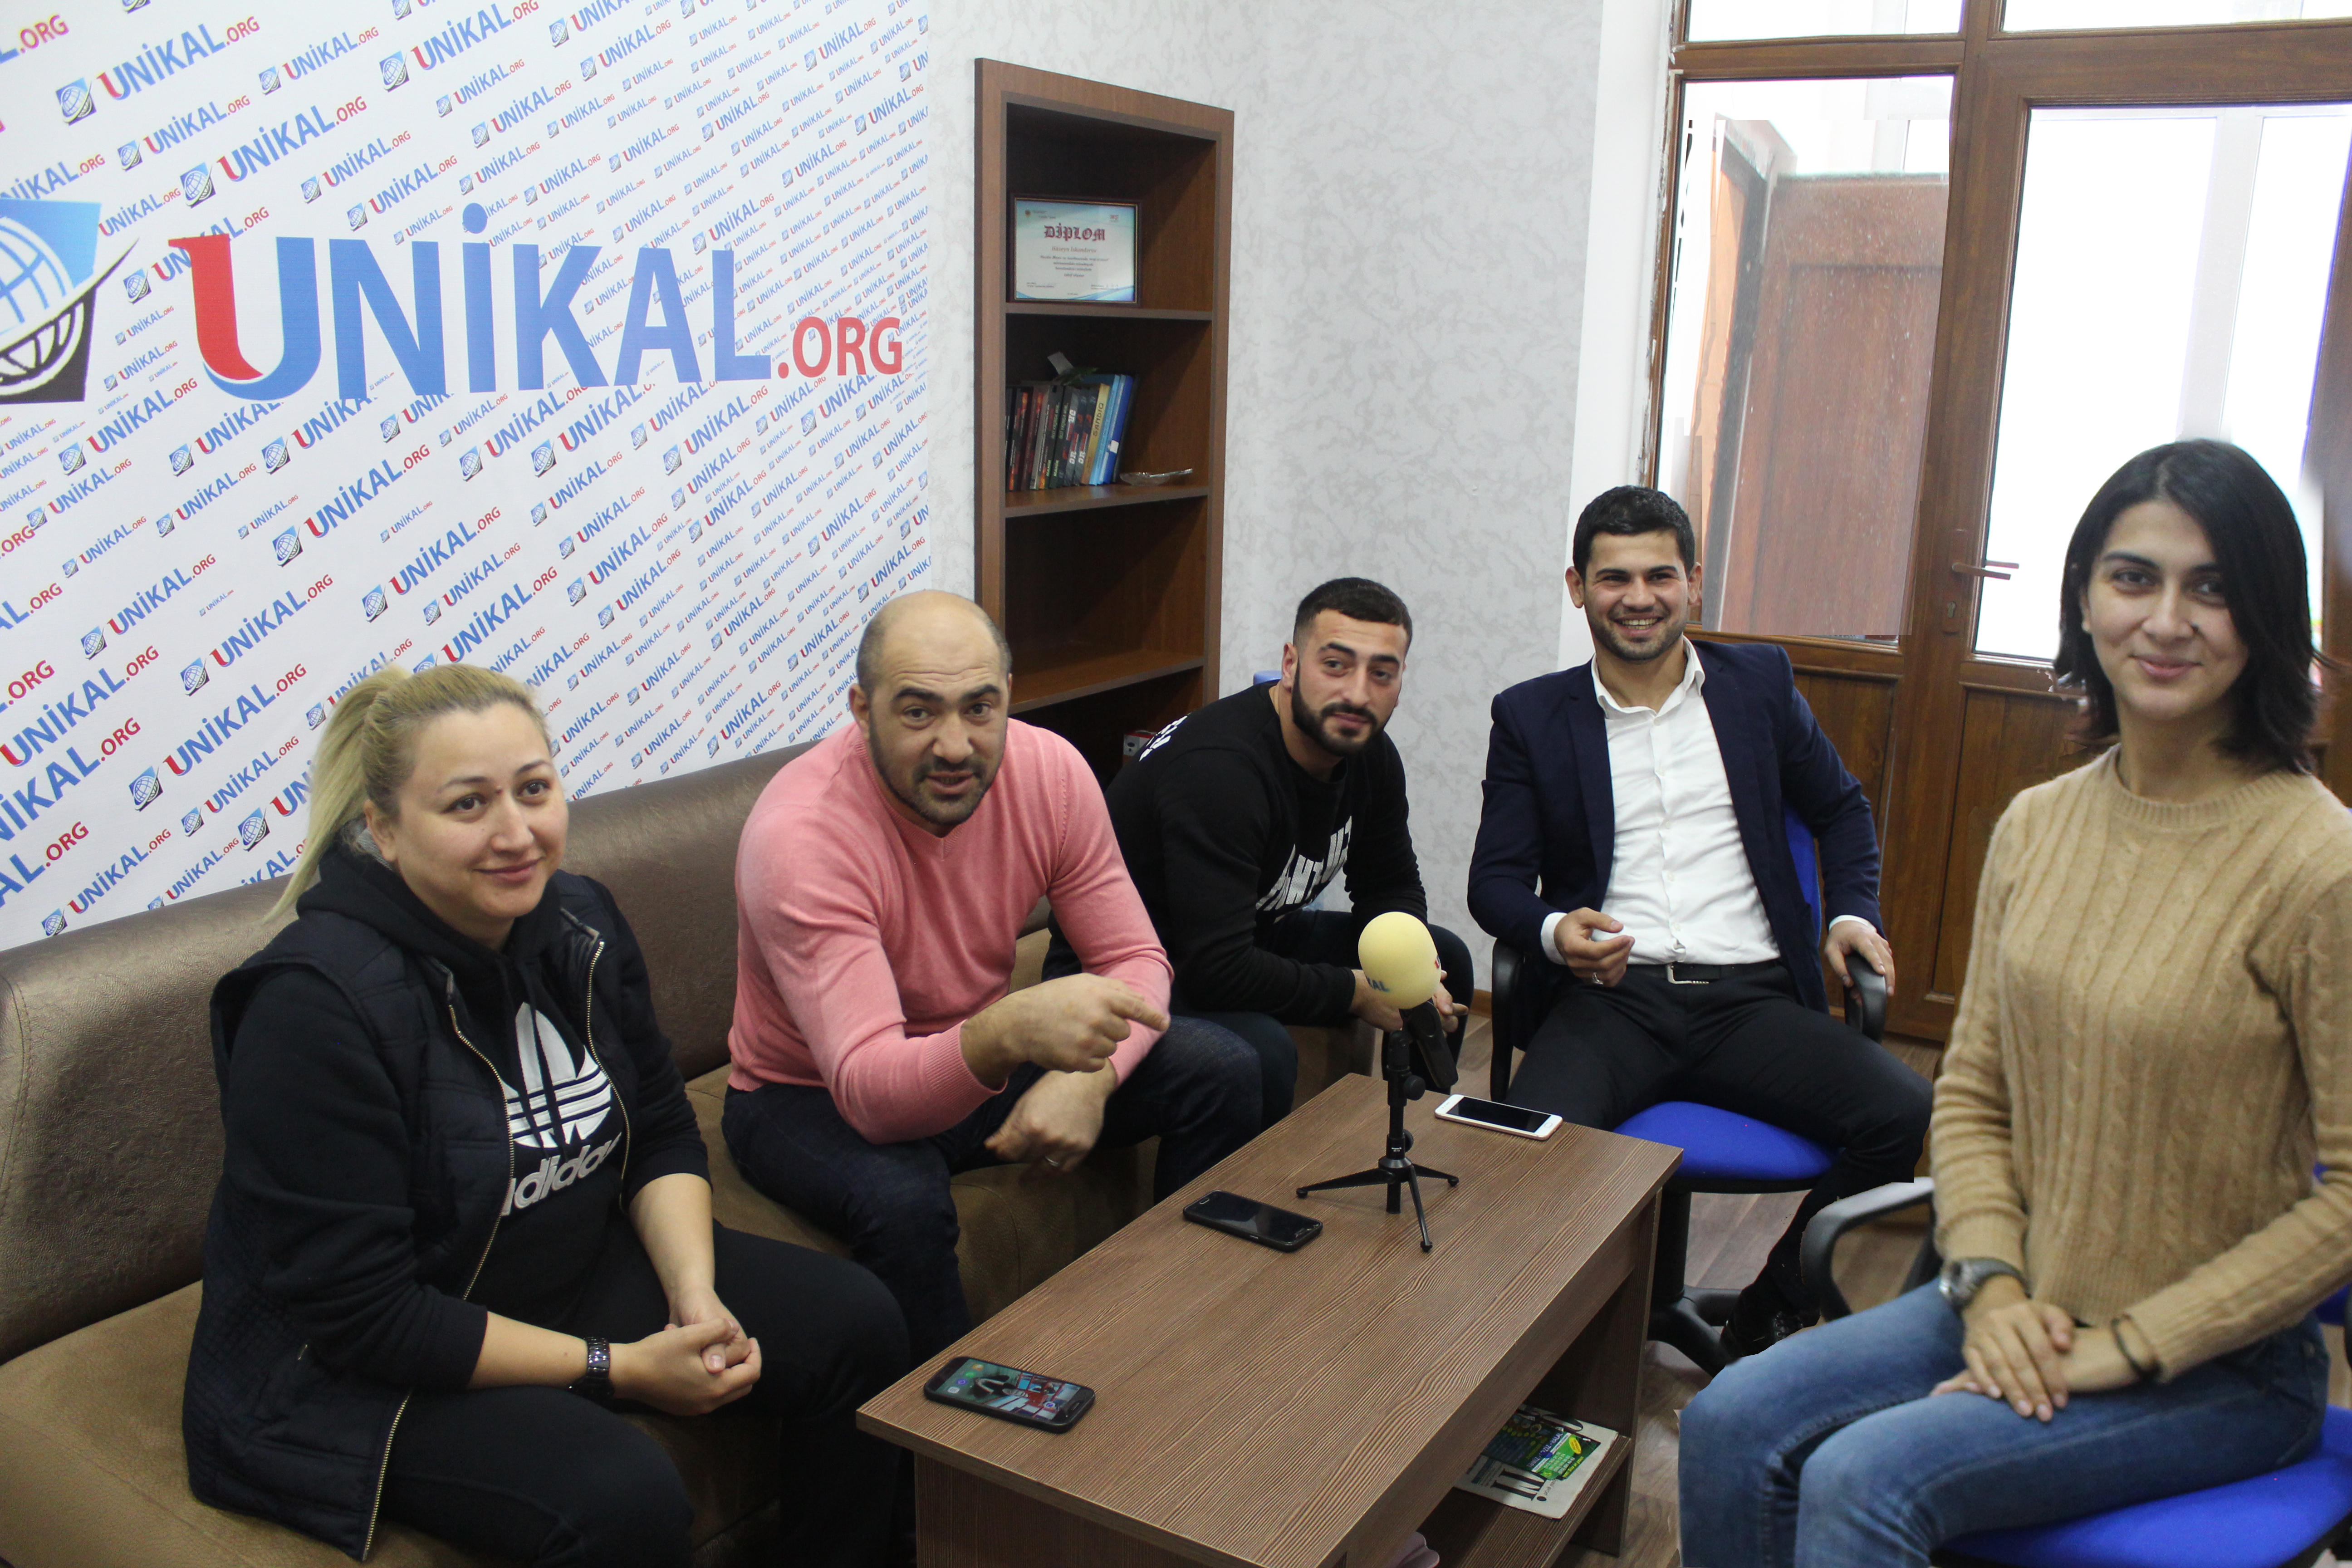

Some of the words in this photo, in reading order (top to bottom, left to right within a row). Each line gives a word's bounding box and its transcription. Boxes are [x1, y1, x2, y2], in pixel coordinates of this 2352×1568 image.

[96, 16, 260, 100] UNİKAL.ORG
[283, 27, 379, 80] UNİKAL.ORG
[411, 0, 539, 70] UNİKAL.ORG
[143, 95, 250, 154] UNİKAL.ORG
[217, 96, 367, 182] UNİKAL.ORG
[491, 80, 572, 133] UNİKAL.ORG
[323, 131, 411, 187] UNİKAL.ORG
[369, 155, 457, 214] UNİKAL.ORG
[98, 188, 181, 236] UNİKAL.ORG
[1044, 223, 1105, 241] DİPLOM
[168, 203, 902, 401] UNİKAL.ORG
[87, 378, 197, 453] UNİKAL.ORG
[684, 386, 768, 454] UNİKAL.ORG
[48, 459, 132, 514] UNİKAL.ORG
[175, 463, 256, 520] UNİKAL.ORG
[304, 444, 430, 538] UNİKAL.ORG
[389, 507, 500, 595] UNİKAL.ORG
[442, 543, 520, 607] UNİKAL.ORG
[588, 513, 668, 585] UNİKAL.ORG
[107, 554, 216, 635] UNİKAL.ORG
[210, 574, 333, 667] UNİKAL.ORG
[441, 566, 557, 663] UNİKAL.ORG
[0, 646, 159, 767] UNİKAL.ORG
[163, 663, 307, 776] UNİKAL.ORG
[204, 736, 299, 813] UNİKAL.ORG
[68, 829, 171, 914] UNİKAL.ORG
